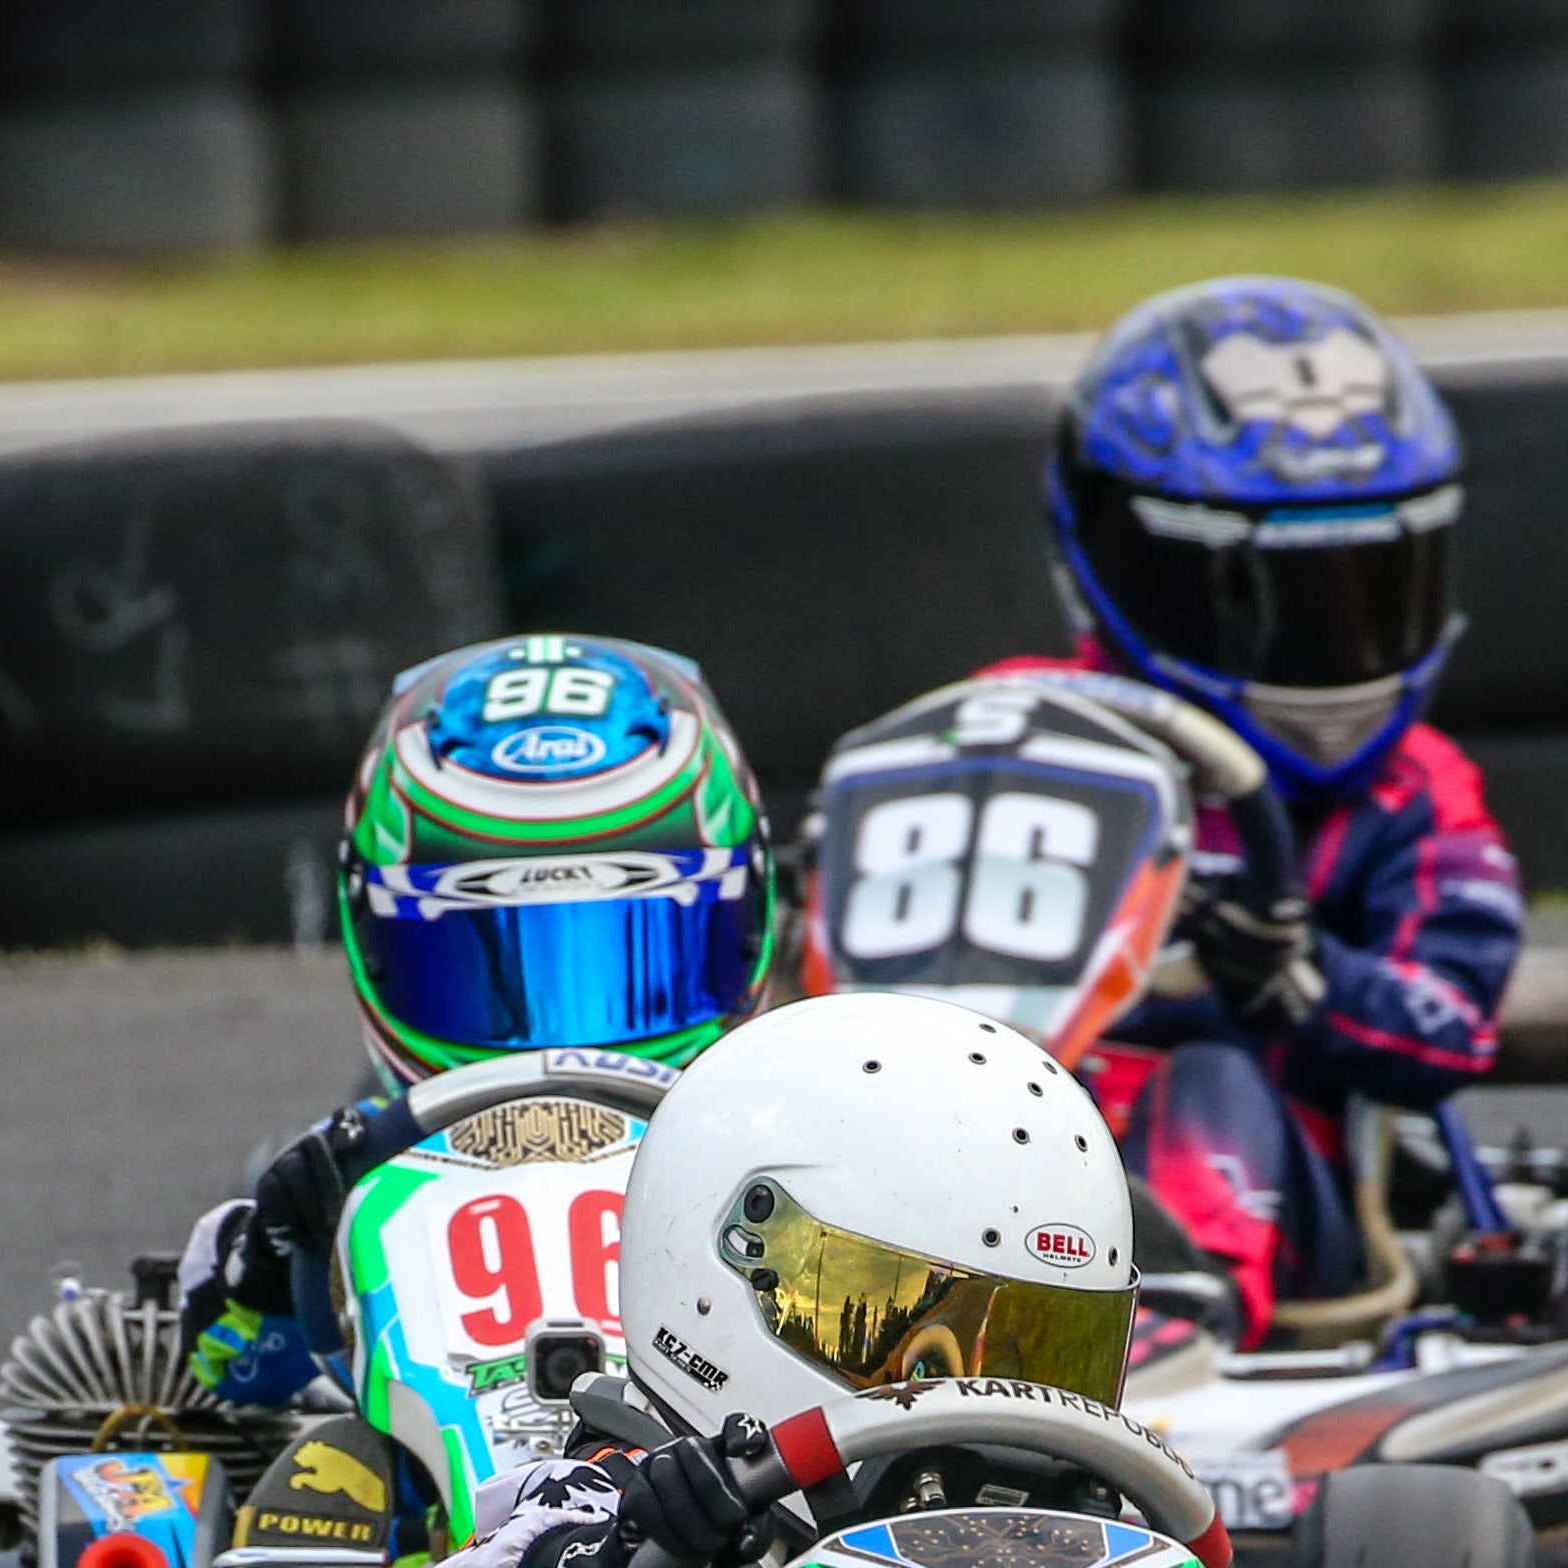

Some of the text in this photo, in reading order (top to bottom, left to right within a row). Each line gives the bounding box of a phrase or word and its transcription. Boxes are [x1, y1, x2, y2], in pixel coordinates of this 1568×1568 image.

[483, 667, 616, 722] 96
[842, 791, 1098, 962] 86
[447, 1189, 626, 1347] 96
[1037, 1232, 1090, 1257] BELL
[656, 1326, 729, 1388] KC7-CMR
[257, 1512, 373, 1541] POWER
